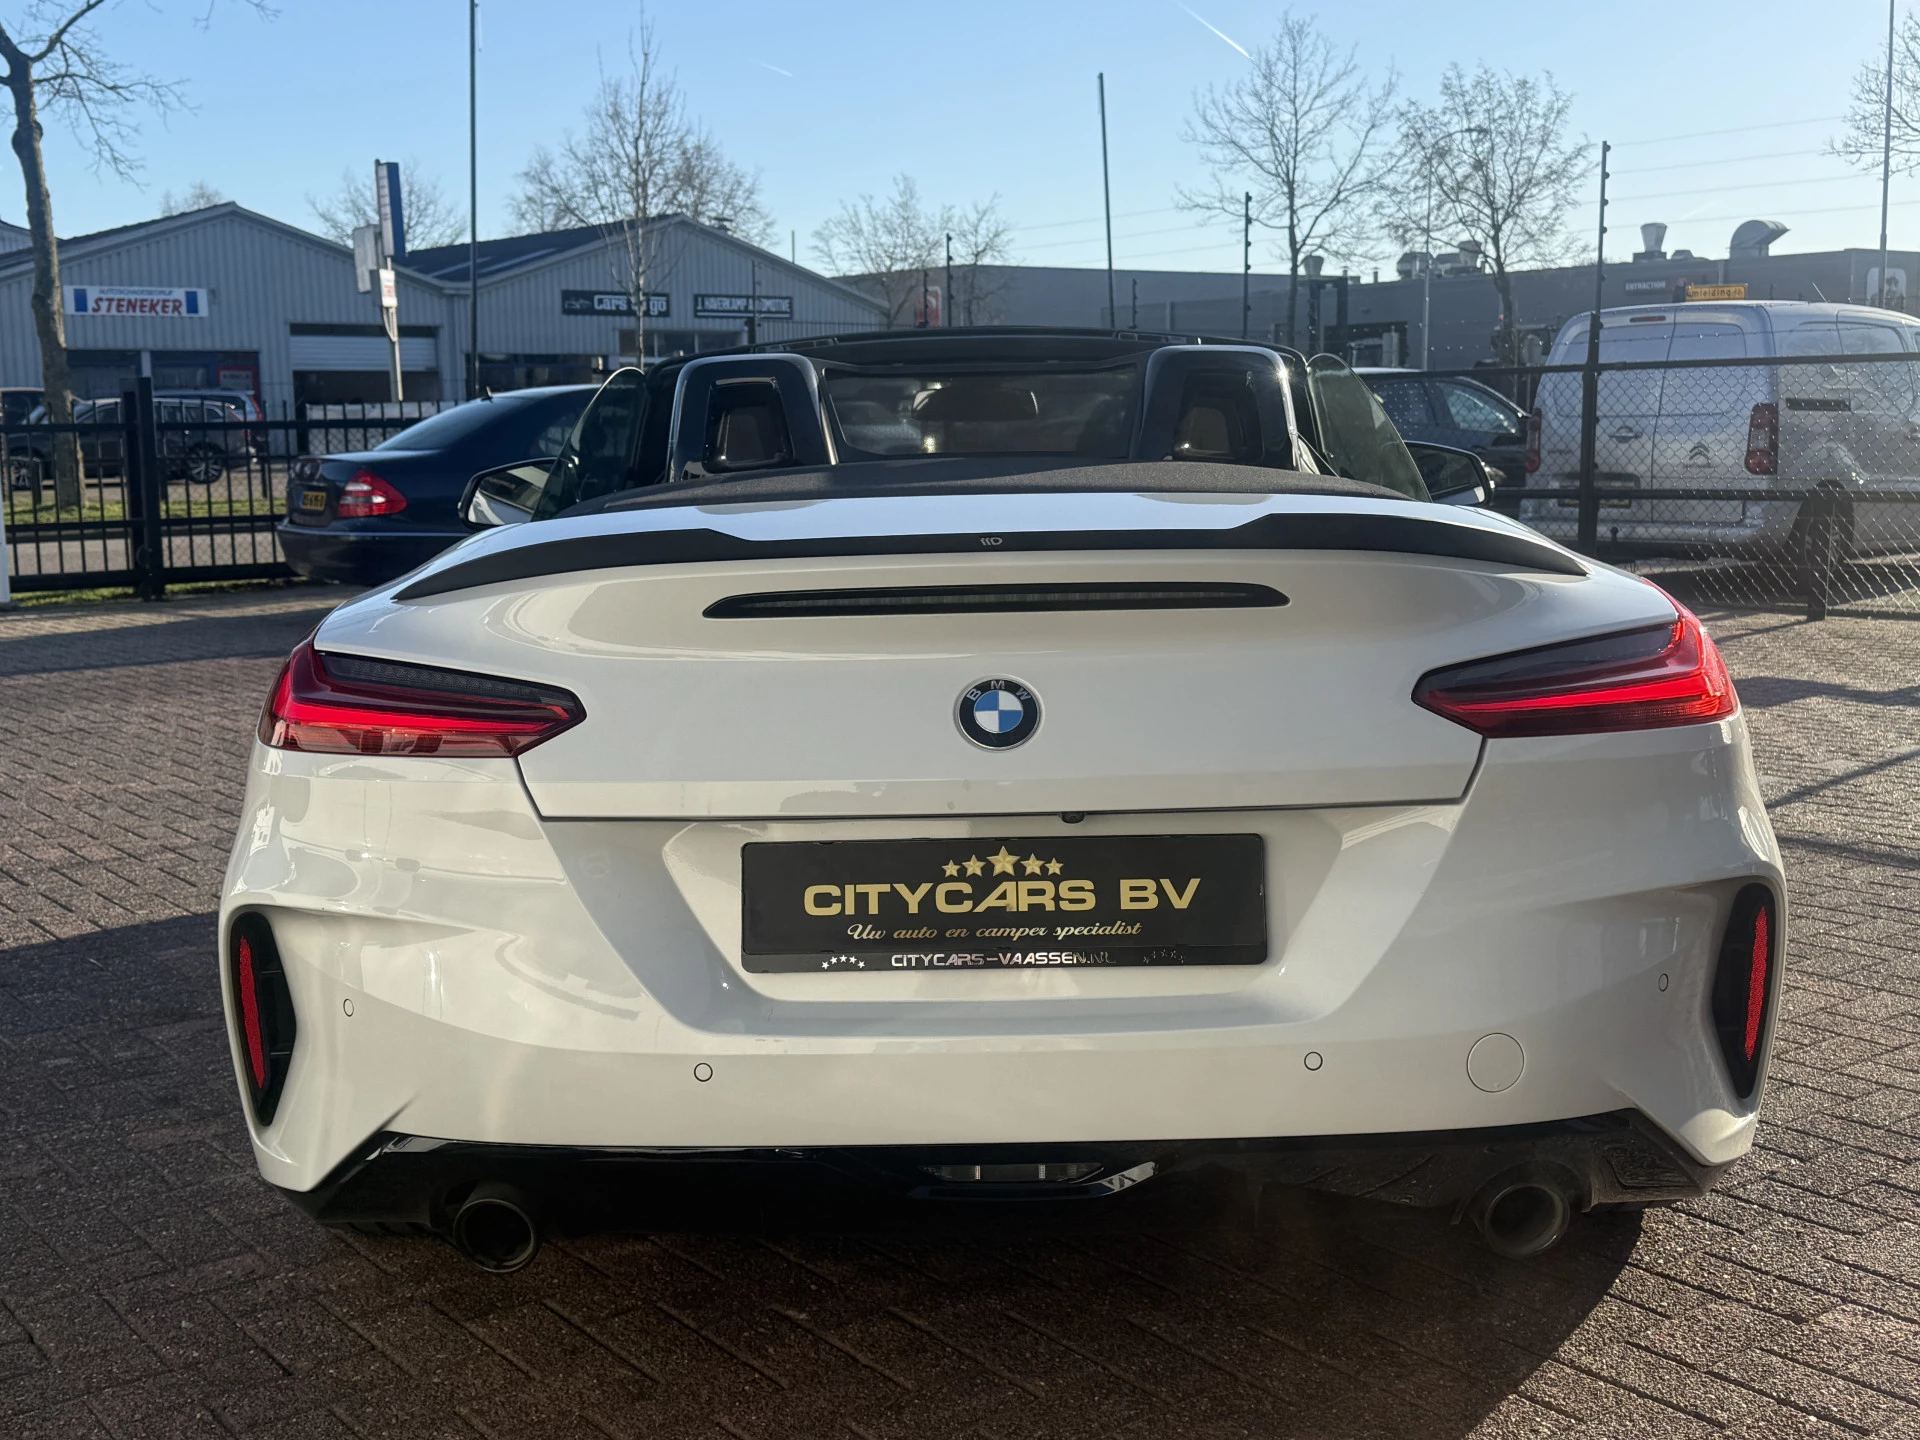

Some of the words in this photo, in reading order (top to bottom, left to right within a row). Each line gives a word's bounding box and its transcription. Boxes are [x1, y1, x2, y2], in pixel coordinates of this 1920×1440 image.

[92, 297, 183, 315] STENEKER
[594, 294, 627, 311] Cars
[649, 296, 667, 316] go
[966, 680, 1032, 701] BMW
[803, 878, 1097, 916] CITYCARS
[1119, 877, 1202, 910] BV
[847, 923, 886, 940] Uw
[893, 927, 938, 940] auto
[945, 928, 970, 939] en
[976, 925, 1049, 942] camper
[1053, 920, 1143, 938] specialist
